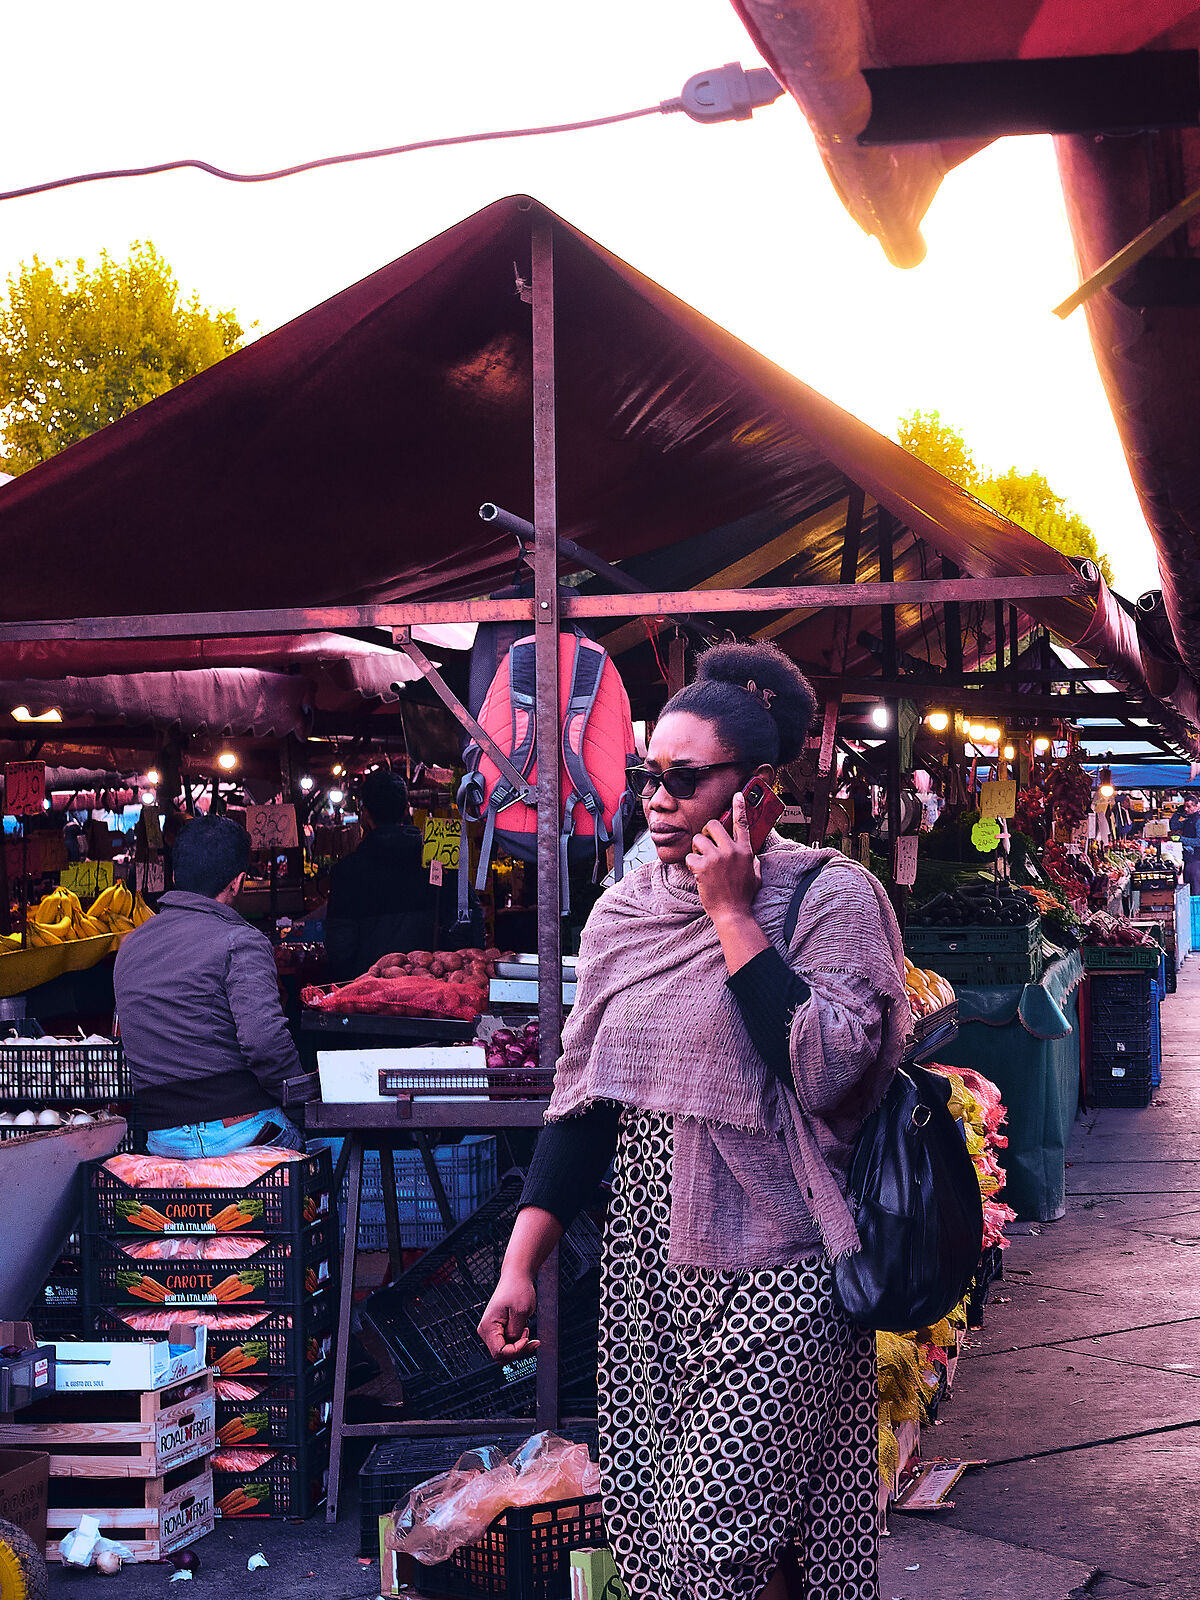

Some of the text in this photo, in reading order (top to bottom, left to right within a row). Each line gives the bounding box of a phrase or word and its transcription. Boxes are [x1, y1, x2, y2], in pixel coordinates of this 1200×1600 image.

[165, 1203, 213, 1218] CAROTE
[185, 1222, 217, 1231] ITALIANA
[166, 1274, 214, 1289] CAROTE
[186, 1293, 218, 1302] ITALIANA
[161, 1415, 211, 1453] ROYAL FRUIT
[164, 1496, 210, 1537] ROYAL FRUIT
